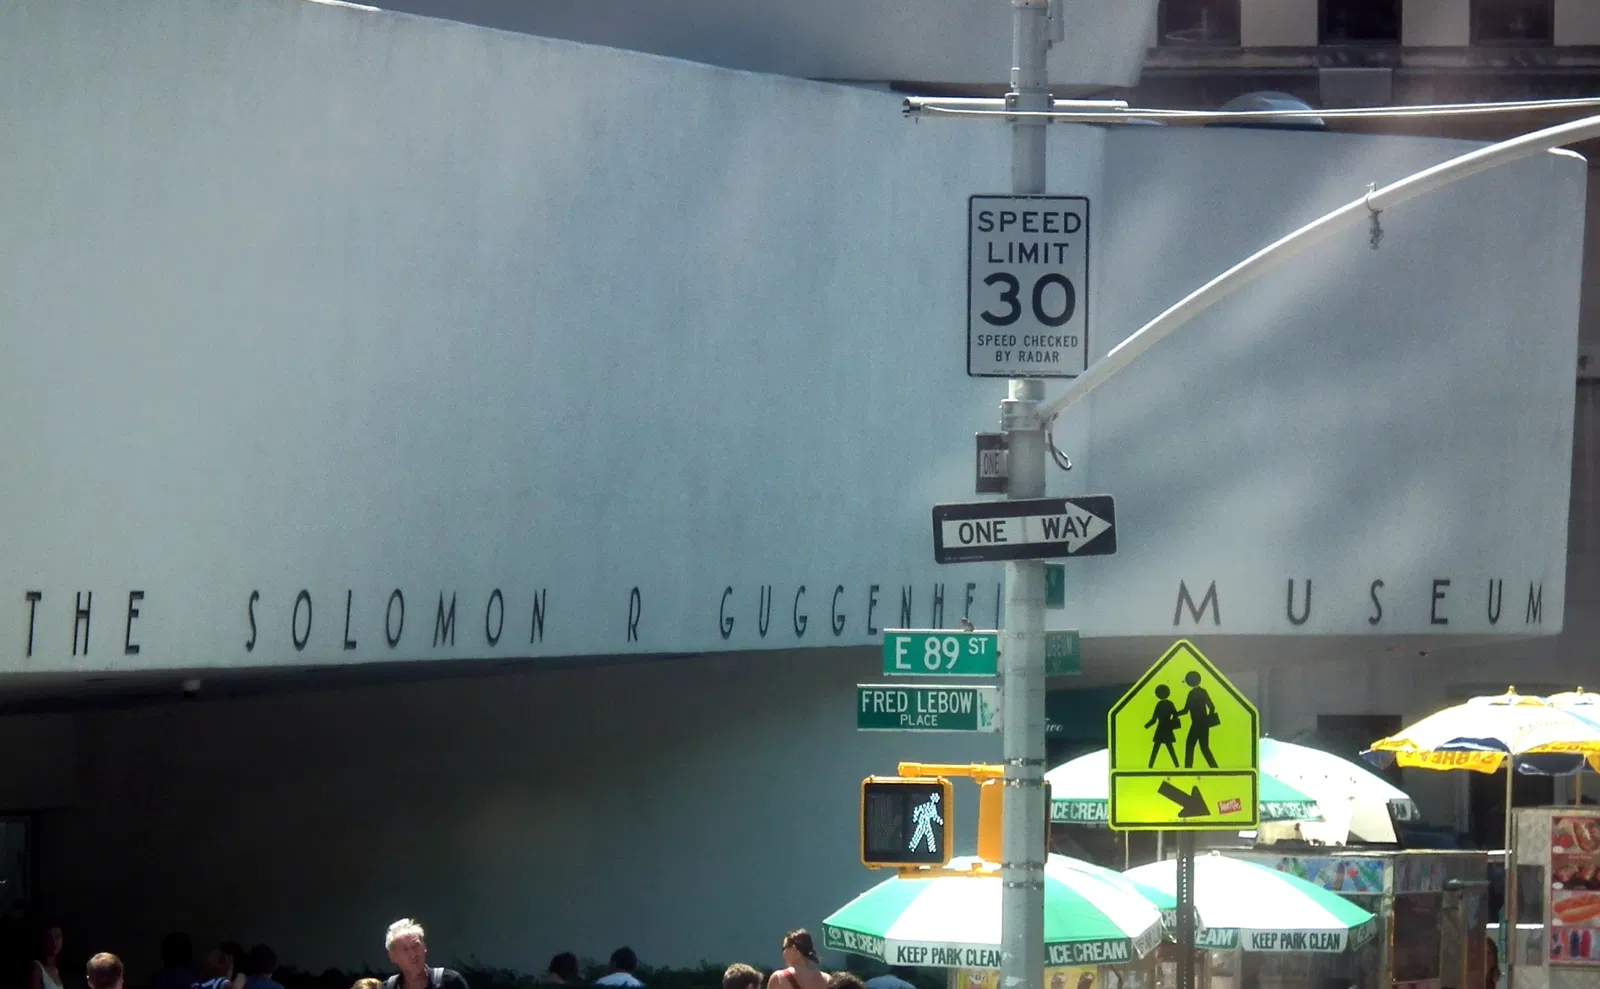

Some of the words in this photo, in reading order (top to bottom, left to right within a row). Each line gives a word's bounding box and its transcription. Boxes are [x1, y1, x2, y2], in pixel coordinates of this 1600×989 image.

[977, 211, 1081, 234] SPEED
[988, 241, 1069, 264] LIMIT
[980, 272, 1076, 327] 30
[977, 334, 1017, 347] SPEED
[1023, 335, 1078, 348] CHECKED
[995, 351, 1012, 362] BY
[1018, 351, 1060, 363] RADAR
[983, 452, 999, 475] ONE
[958, 520, 1007, 545] ONE
[1042, 515, 1093, 540] WAY
[26, 590, 144, 657] THE
[245, 588, 547, 652] SOLOMON
[627, 585, 642, 642] R
[719, 583, 1001, 638] GUGGENHEI
[1173, 578, 1543, 627] MUSEUM
[895, 637, 912, 669] E
[924, 636, 960, 670] 89
[968, 637, 989, 655] ST
[862, 690, 909, 713] FRED
[917, 691, 973, 714] LEBOW
[900, 714, 938, 726] PLACE
[1050, 801, 1069, 820] ICE
[1070, 802, 1108, 820] CREA
[1195, 928, 1233, 946] EAM
[1252, 932, 1278, 949] KEEP
[1280, 932, 1307, 949] PARK
[1309, 932, 1341, 950] CLEAN
[897, 945, 928, 964] KEEP
[931, 947, 963, 966] PARK
[966, 948, 1002, 968] CLEAN
[1048, 944, 1073, 964] ICE
[1074, 941, 1128, 962] CREAM
